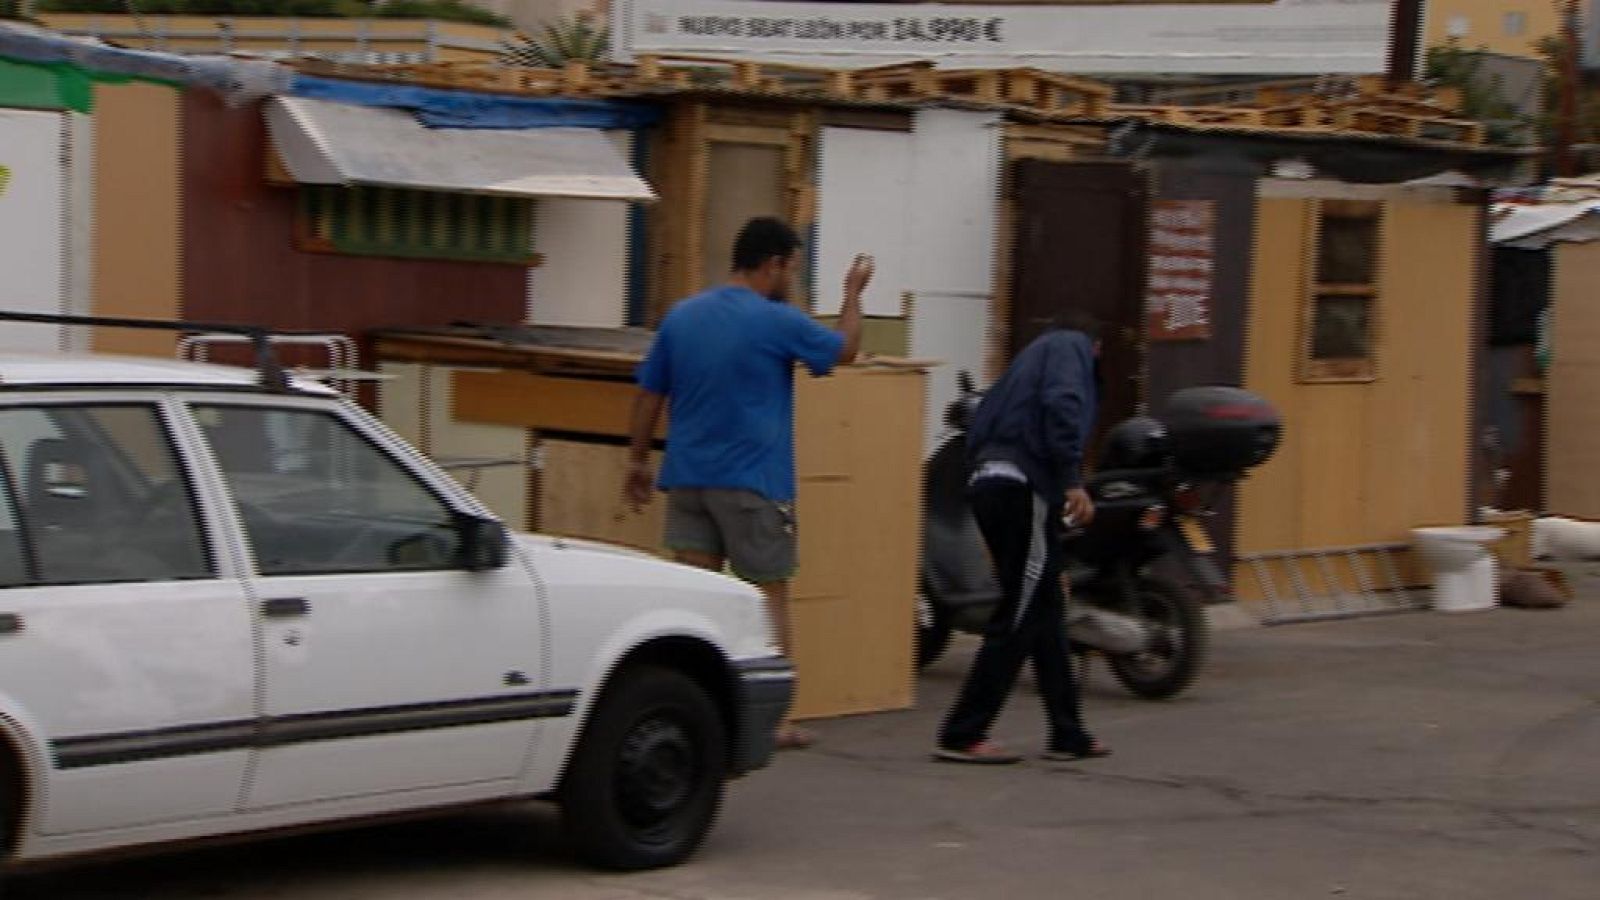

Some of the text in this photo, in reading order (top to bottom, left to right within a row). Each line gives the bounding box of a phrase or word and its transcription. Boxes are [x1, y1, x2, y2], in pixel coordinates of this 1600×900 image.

[678, 16, 742, 37] NUEVO
[745, 17, 793, 38] SEAT
[847, 21, 889, 40] POR
[892, 17, 980, 42] 14.990
[983, 18, 1004, 42] €
